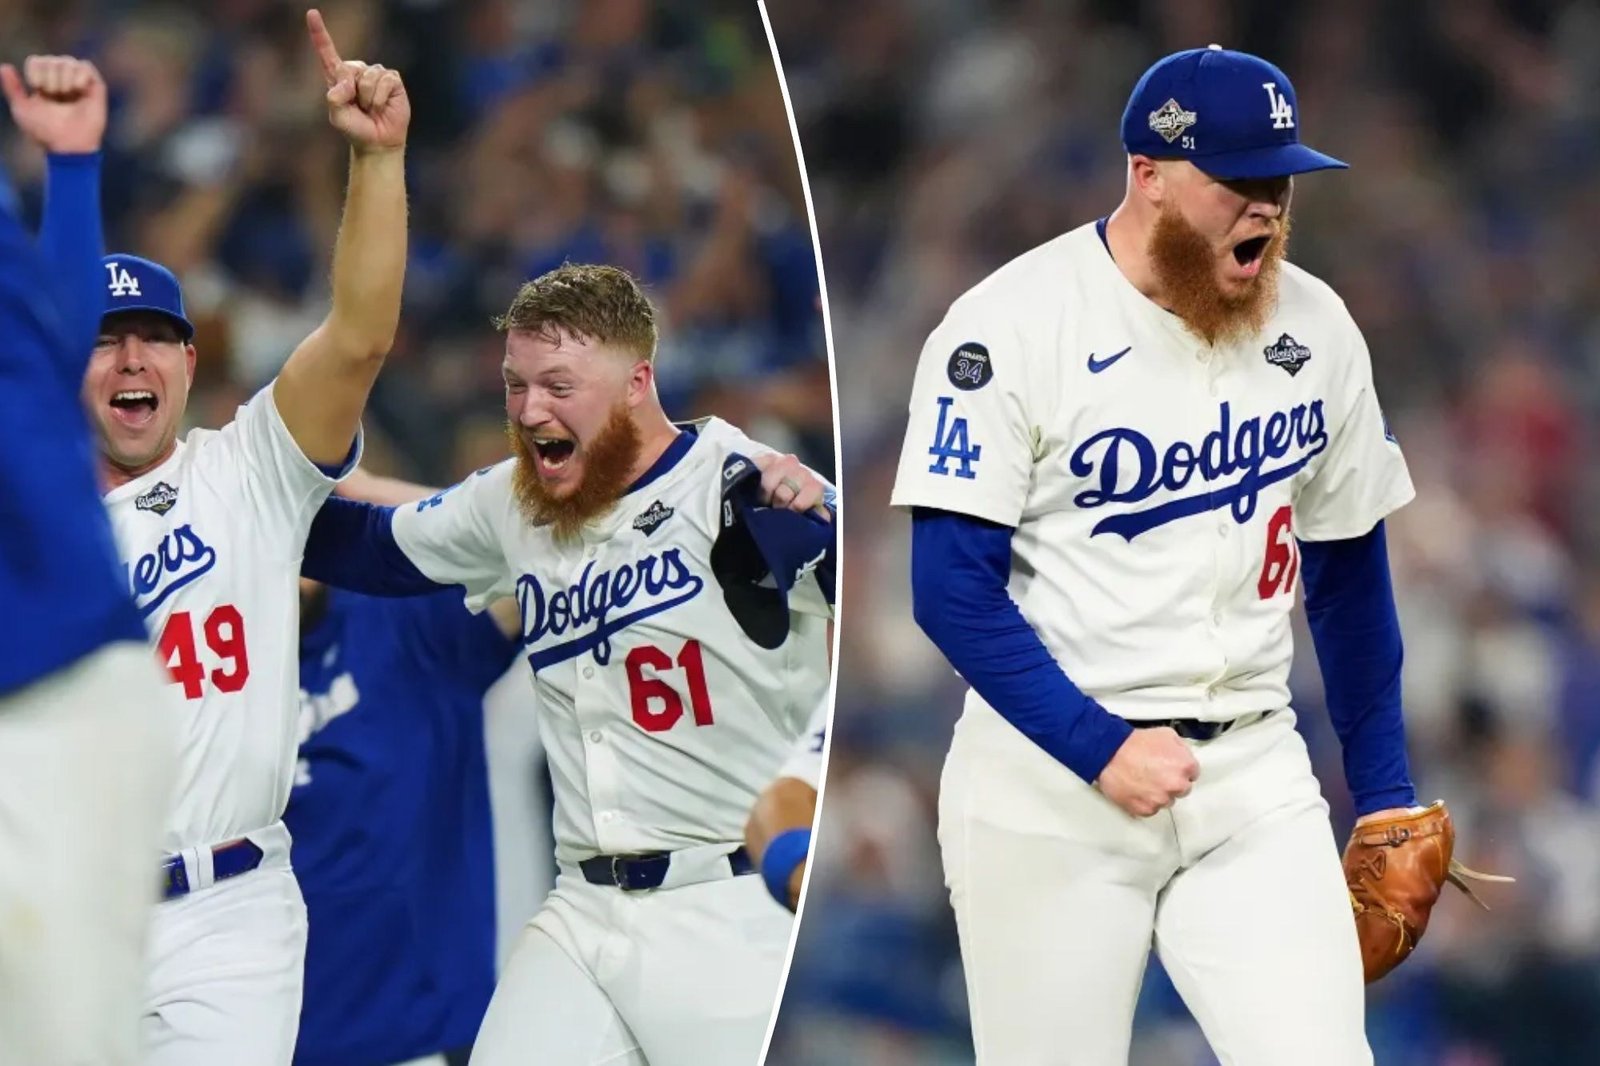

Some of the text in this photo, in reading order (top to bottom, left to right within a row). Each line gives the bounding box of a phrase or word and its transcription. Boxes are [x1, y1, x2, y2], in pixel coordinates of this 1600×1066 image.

[1182, 135, 1196, 149] 51
[1262, 82, 1295, 129] LA
[105, 262, 142, 297] LA
[954, 358, 983, 384] 34
[928, 396, 982, 479] LA
[1070, 399, 1327, 525] Dodgers
[515, 548, 703, 667] Dodgers
[155, 604, 249, 700] 49
[625, 639, 714, 732] 61
